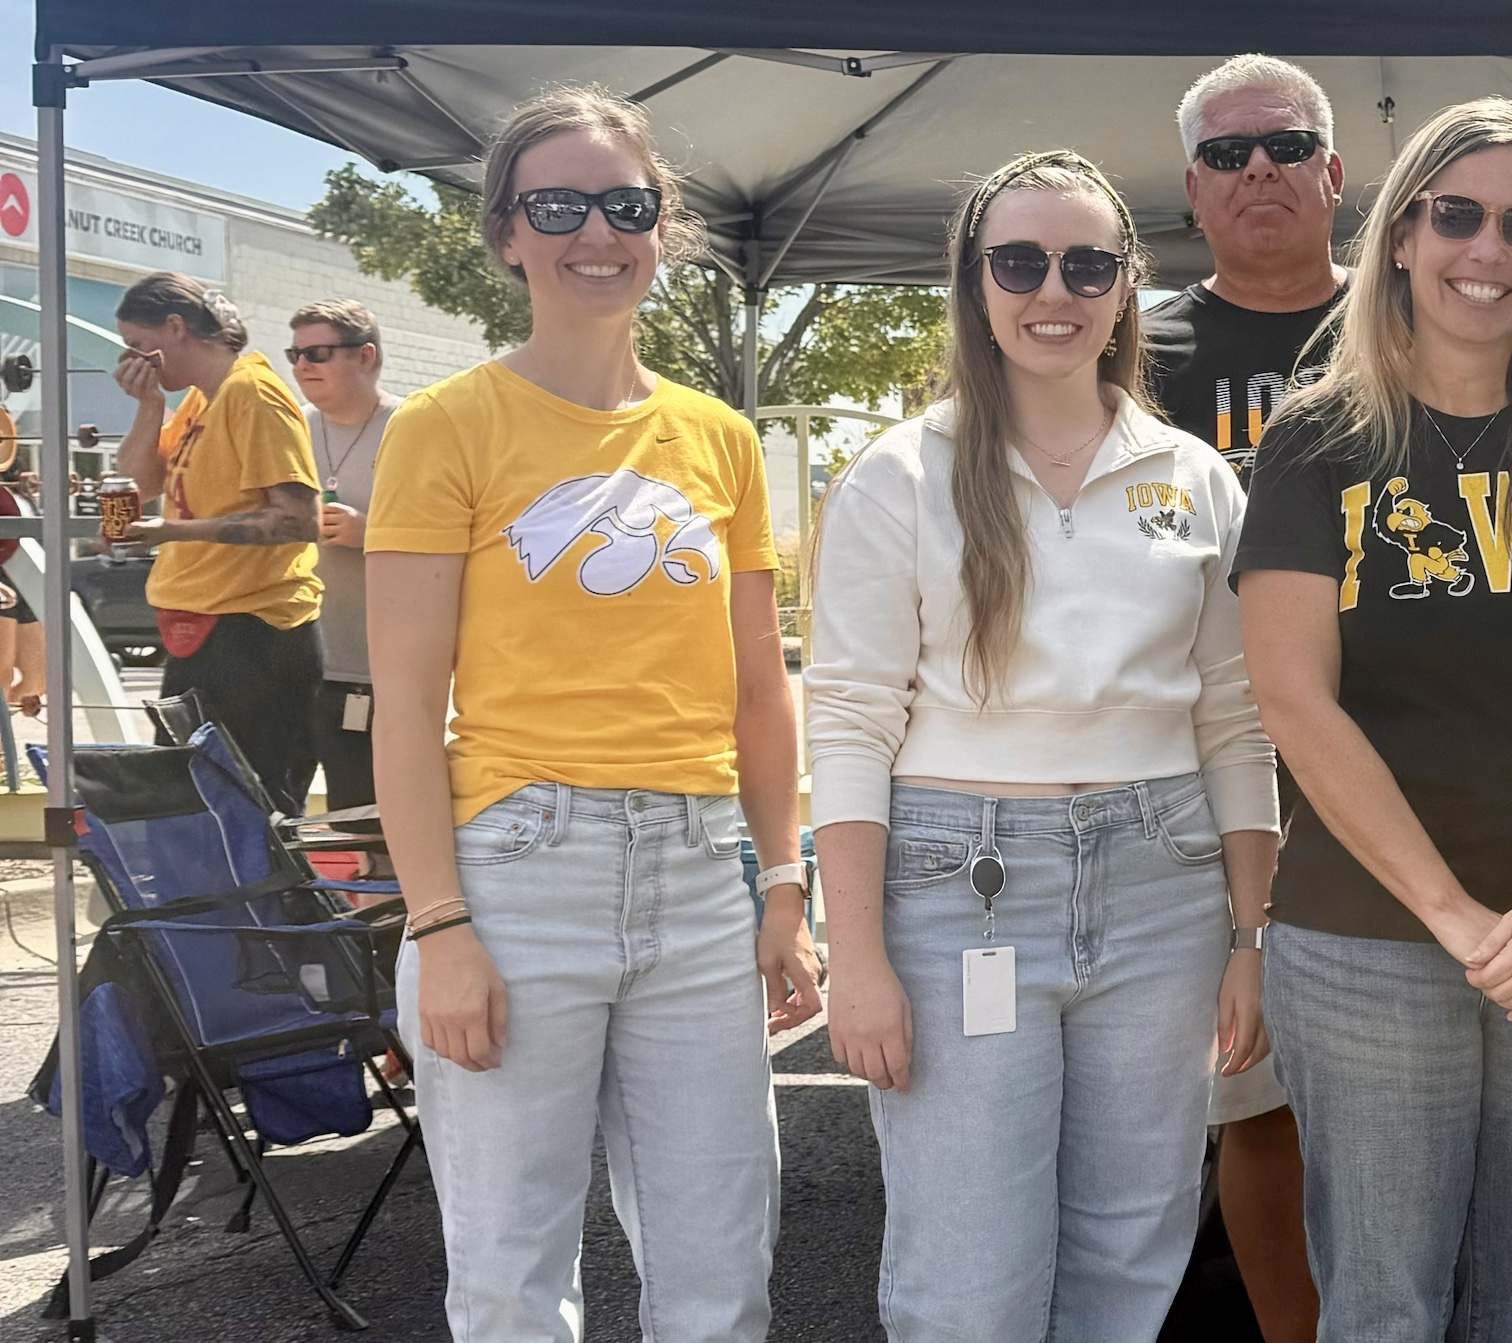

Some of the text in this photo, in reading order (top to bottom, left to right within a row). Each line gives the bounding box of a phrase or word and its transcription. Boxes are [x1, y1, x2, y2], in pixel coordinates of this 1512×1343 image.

[65, 208, 203, 257] NUT CREEK CHURCH
[1125, 482, 1197, 516] IOWA
